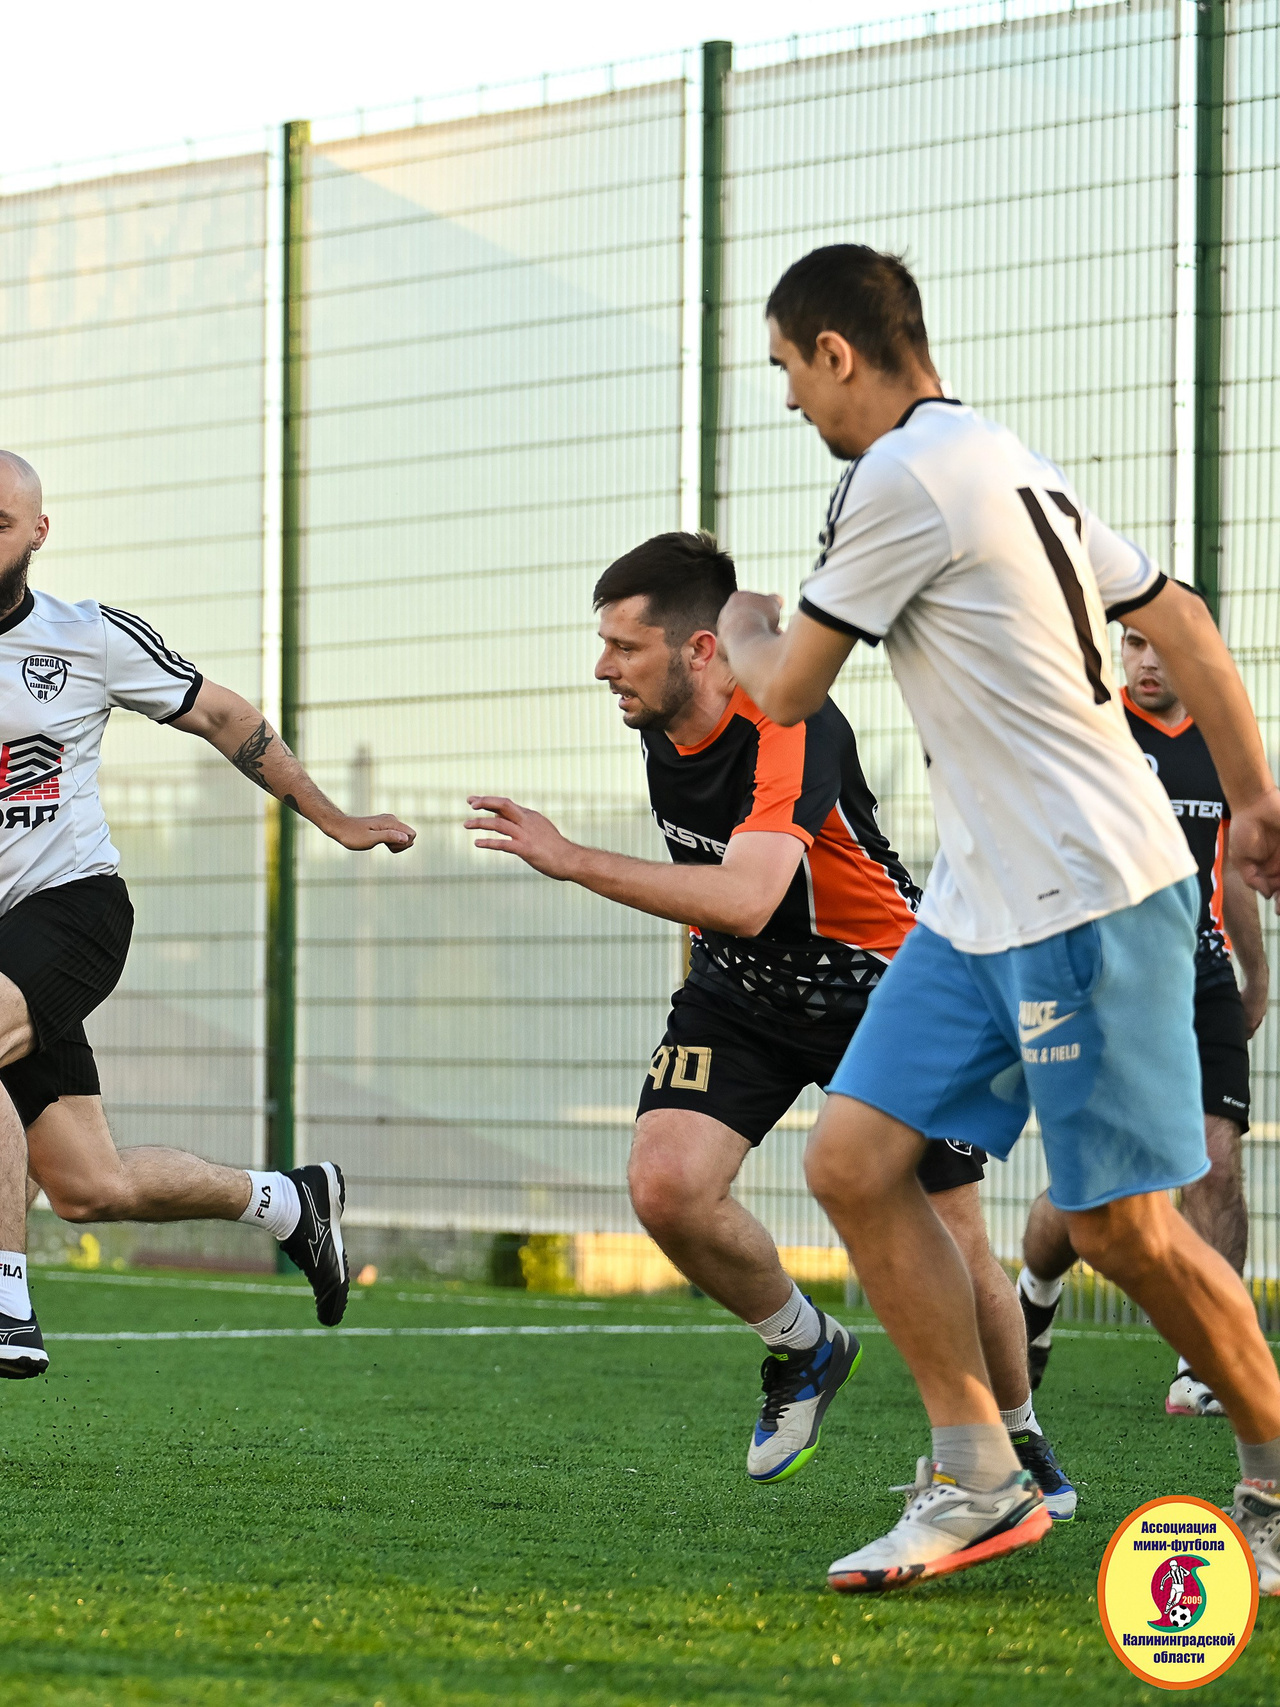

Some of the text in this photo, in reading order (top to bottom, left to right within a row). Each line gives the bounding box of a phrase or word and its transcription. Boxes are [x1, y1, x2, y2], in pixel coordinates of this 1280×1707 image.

[1170, 799, 1223, 819] STER
[1050, 1043, 1080, 1062] FIELD
[254, 1185, 272, 1219] FILA
